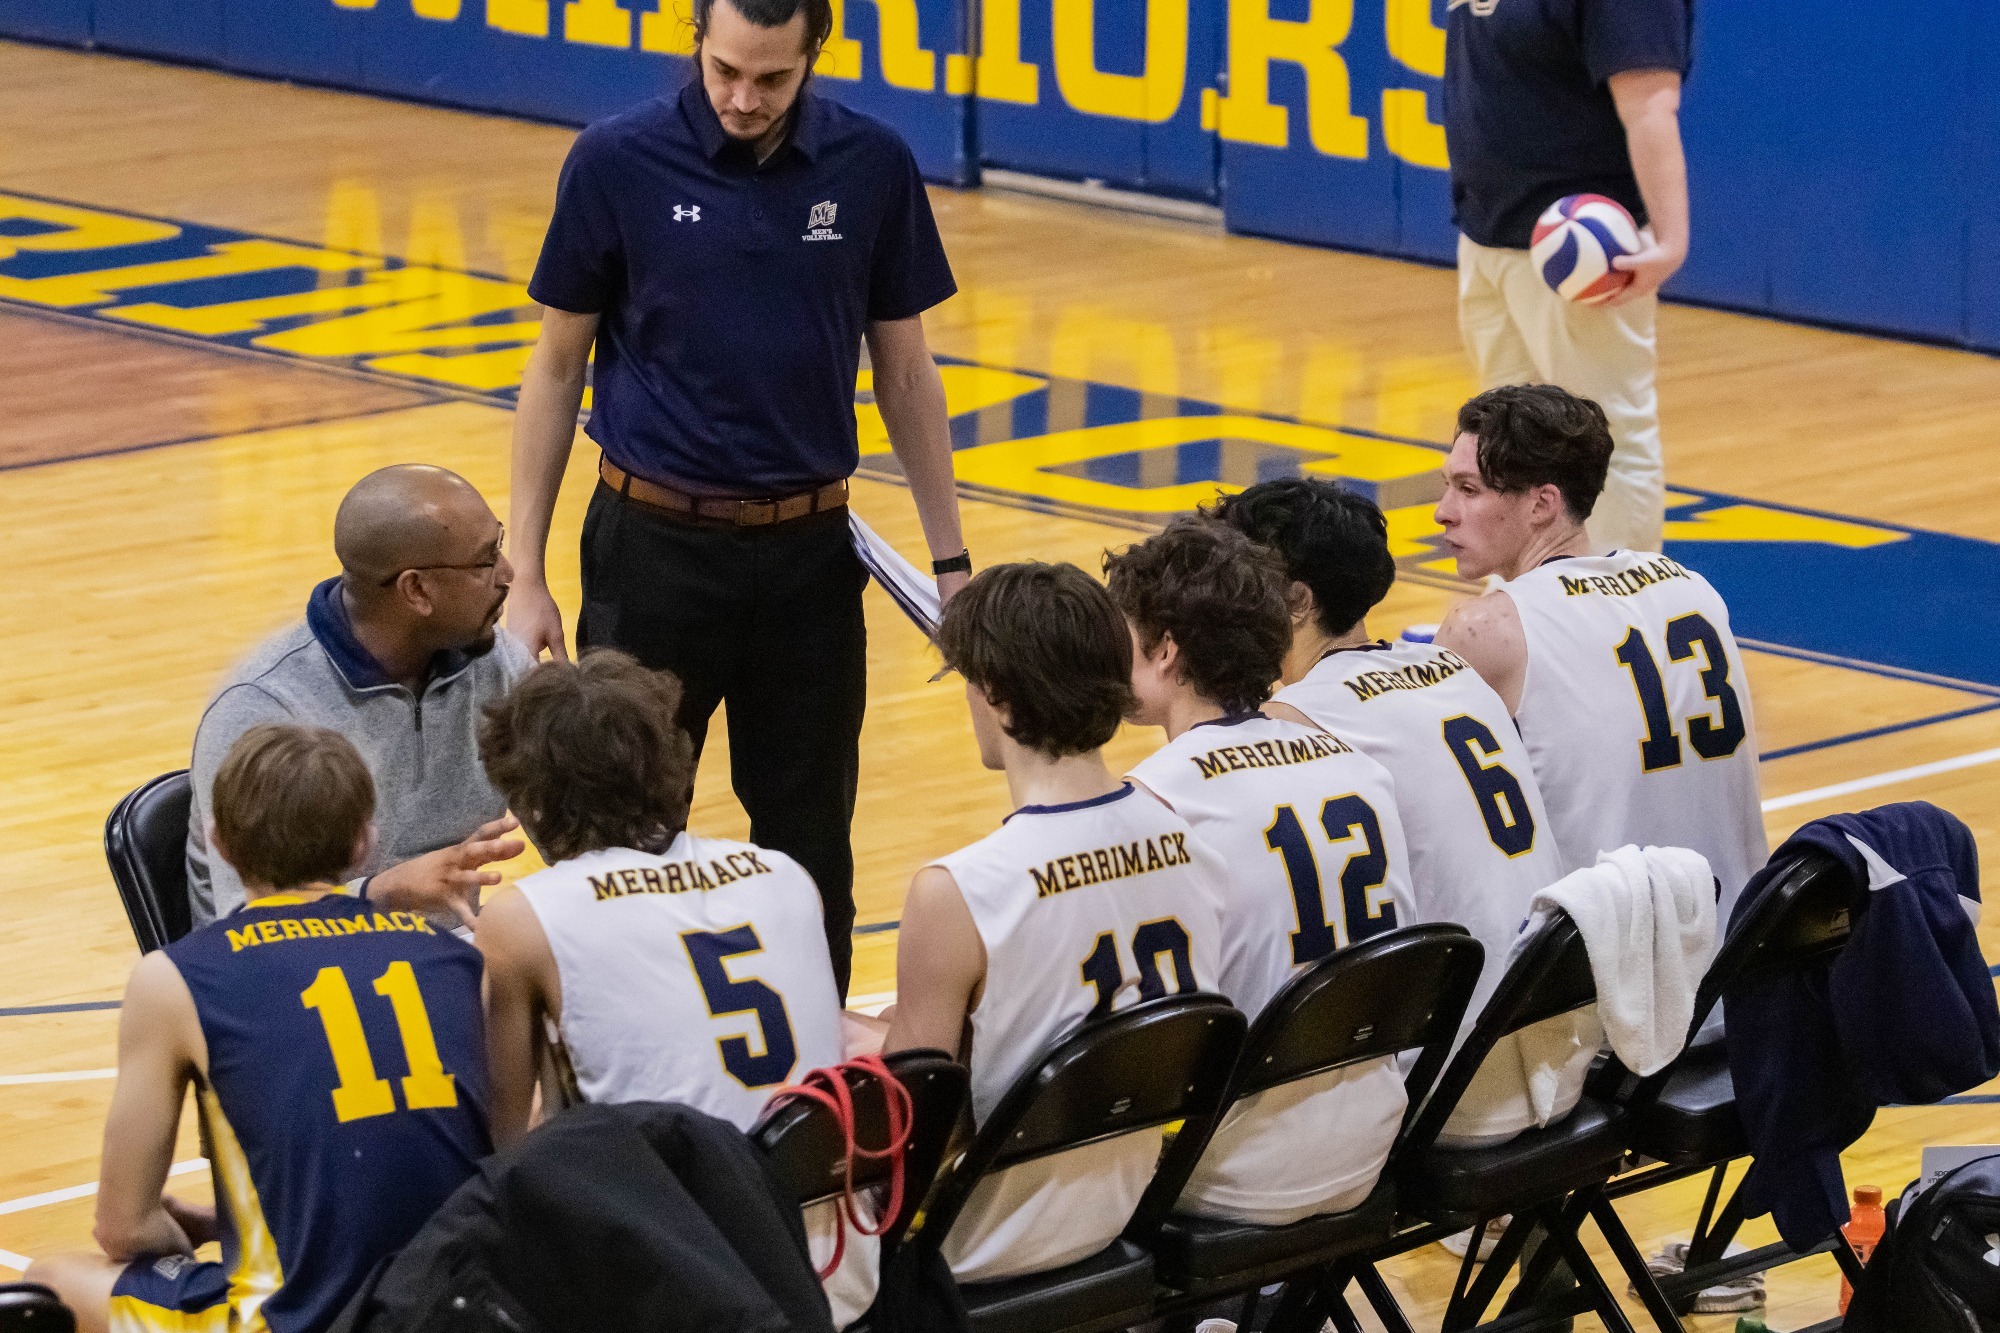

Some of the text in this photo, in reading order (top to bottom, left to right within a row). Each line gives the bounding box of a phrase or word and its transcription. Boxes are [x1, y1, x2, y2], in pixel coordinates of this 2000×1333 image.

[1558, 557, 1691, 597] MRRIMAC
[1343, 650, 1471, 702] MERRIMAC
[1613, 610, 1746, 775] 13
[1190, 733, 1353, 780] MERRIMACK
[1441, 713, 1537, 860] 6
[587, 850, 773, 901] MERRIMACK
[1028, 831, 1191, 899] MERRIMACK
[1262, 791, 1397, 968] 12
[225, 911, 437, 953] MERRIMACK
[1080, 914, 1199, 1012] 10
[301, 960, 458, 1123] 11
[678, 921, 799, 1091] 5
